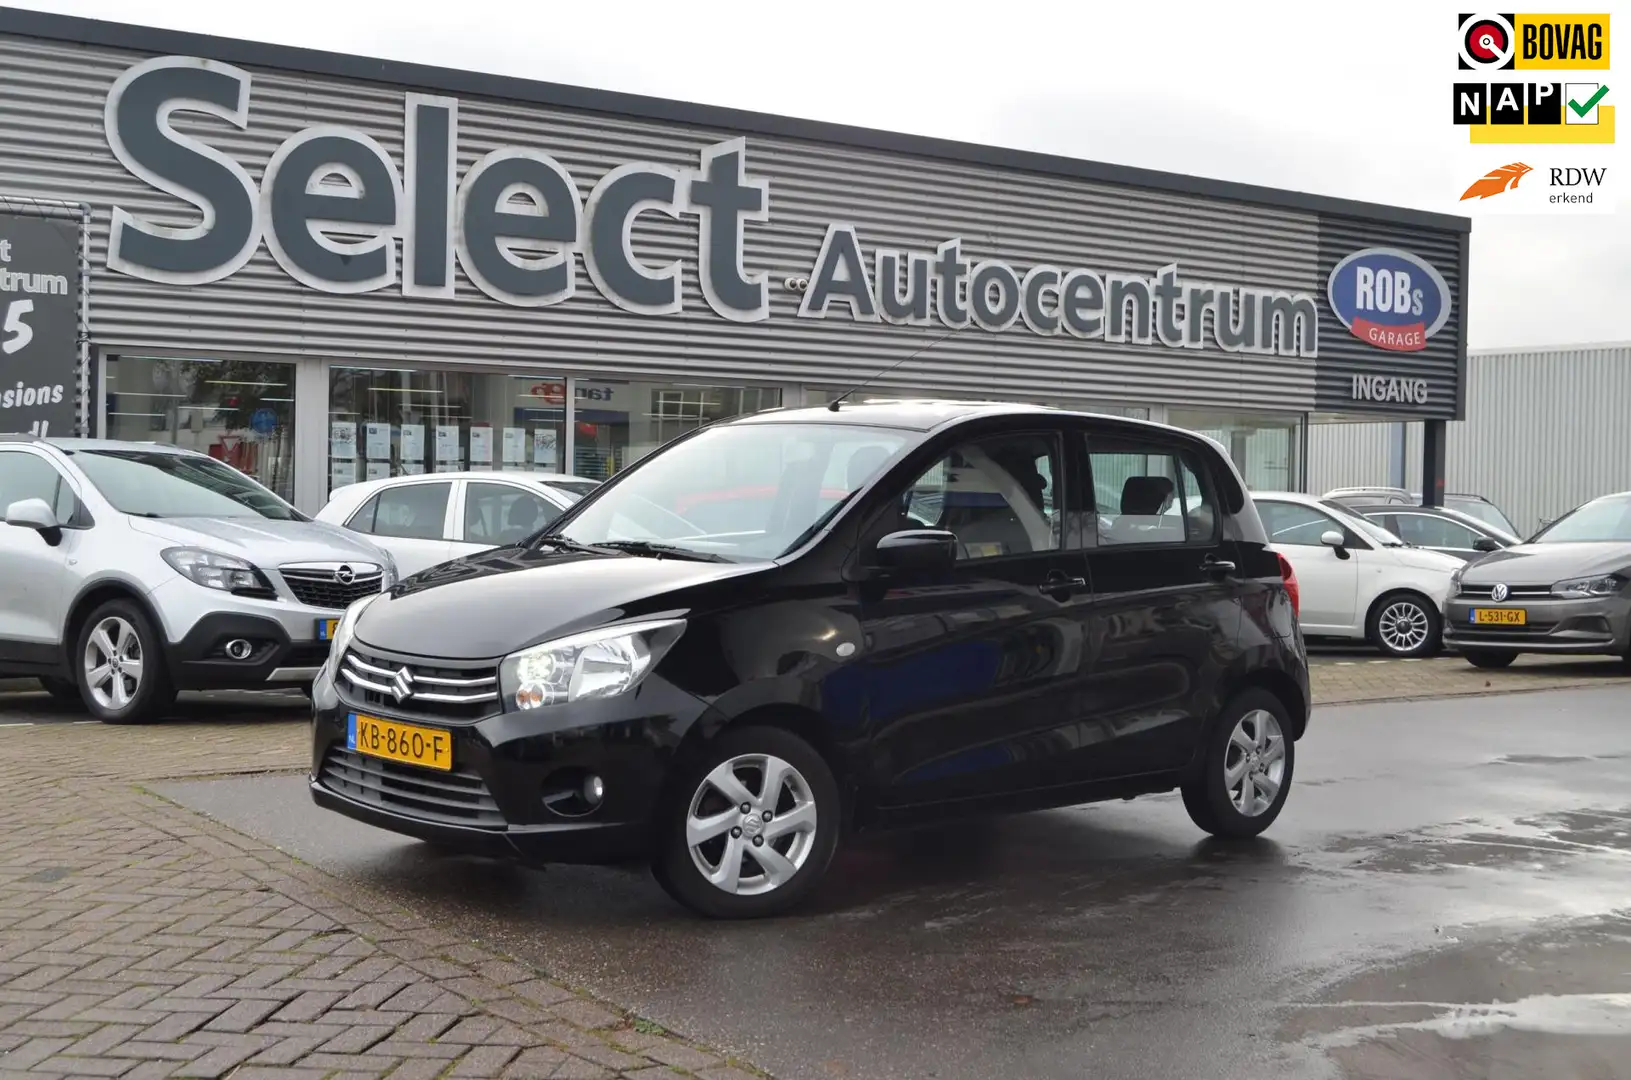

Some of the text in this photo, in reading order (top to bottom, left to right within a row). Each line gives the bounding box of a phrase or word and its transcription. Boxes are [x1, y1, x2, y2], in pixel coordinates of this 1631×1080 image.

[104, 55, 1318, 358] Select Autocentrum
[1369, 327, 1422, 347] GARAGE
[0, 381, 64, 409] sions
[1352, 374, 1428, 404] INGANG
[1479, 611, 1521, 623] L-531-GX
[360, 722, 443, 761] KB-860-F
